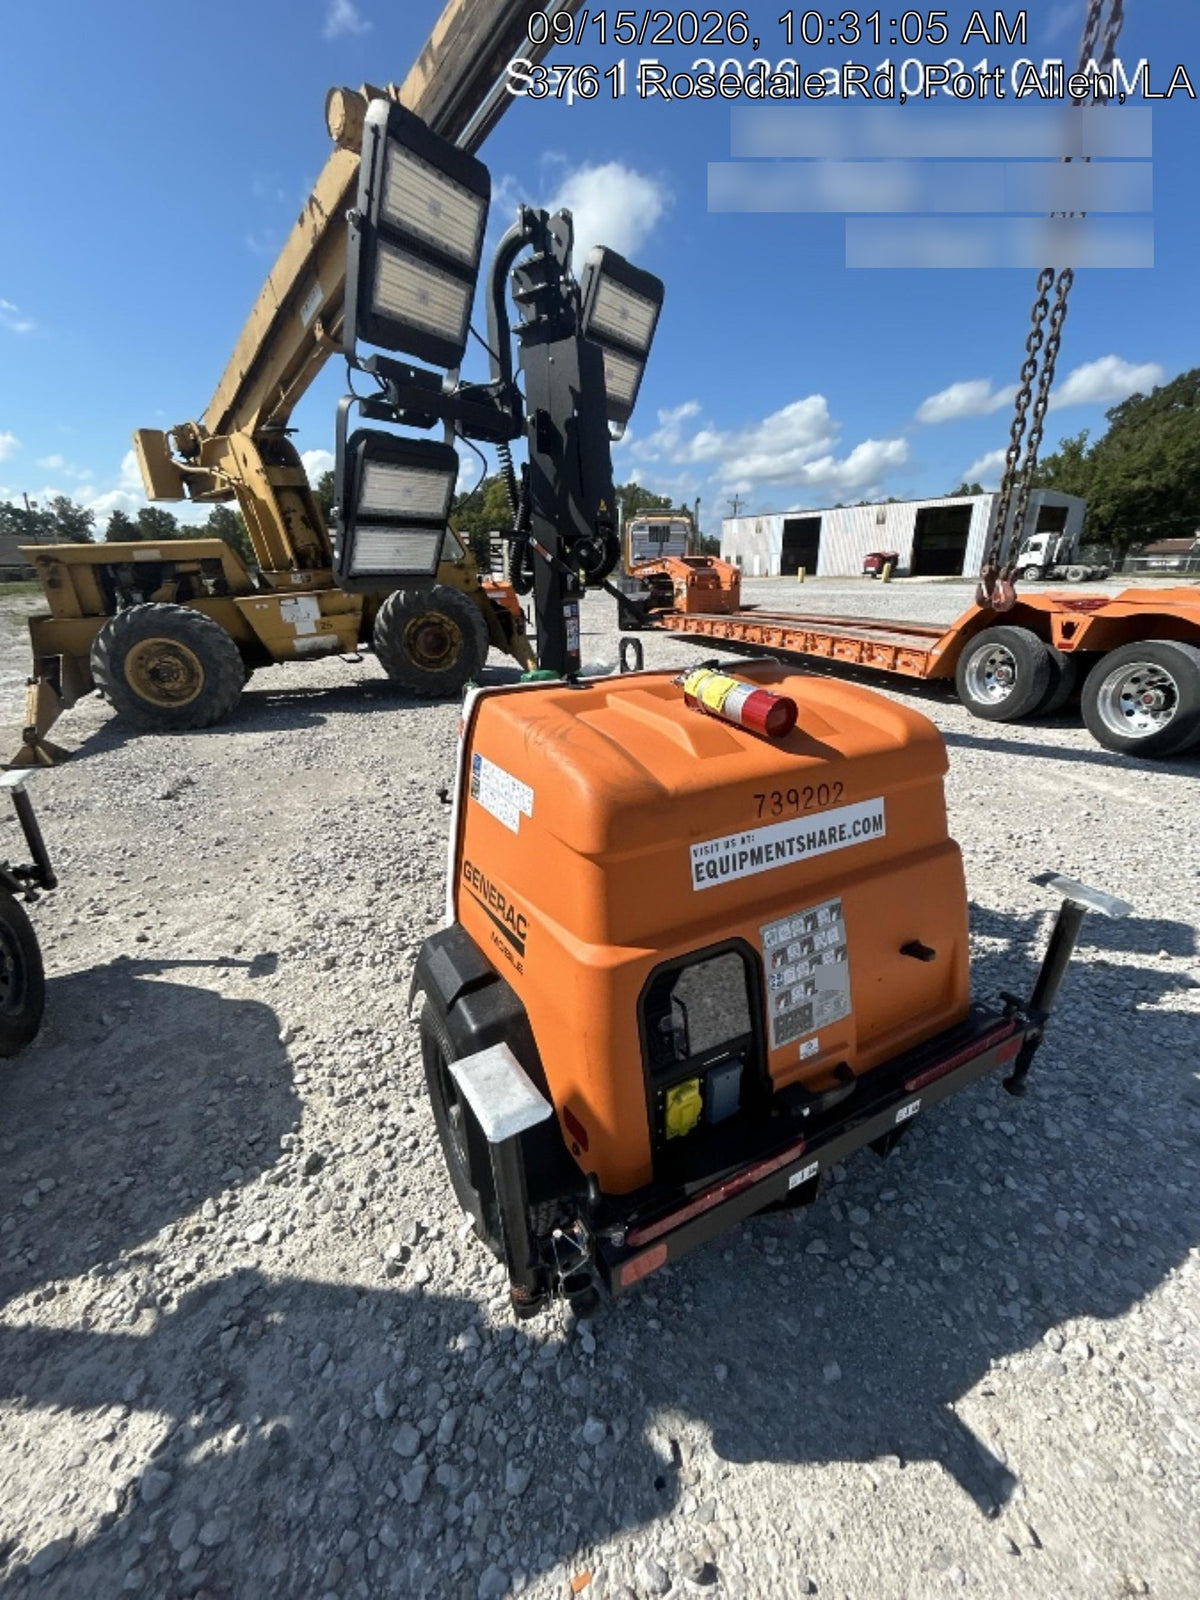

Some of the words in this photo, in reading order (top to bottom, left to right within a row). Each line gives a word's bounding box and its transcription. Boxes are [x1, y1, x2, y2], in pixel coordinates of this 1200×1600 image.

[753, 781, 844, 818] 739202
[693, 842, 719, 857] VISIT
[724, 838, 737, 849] US
[741, 834, 755, 845] AT:
[694, 814, 883, 882] EQUIPMENTSHARE.COM
[463, 860, 527, 941] GENERAC
[491, 931, 524, 976] MOBILE
